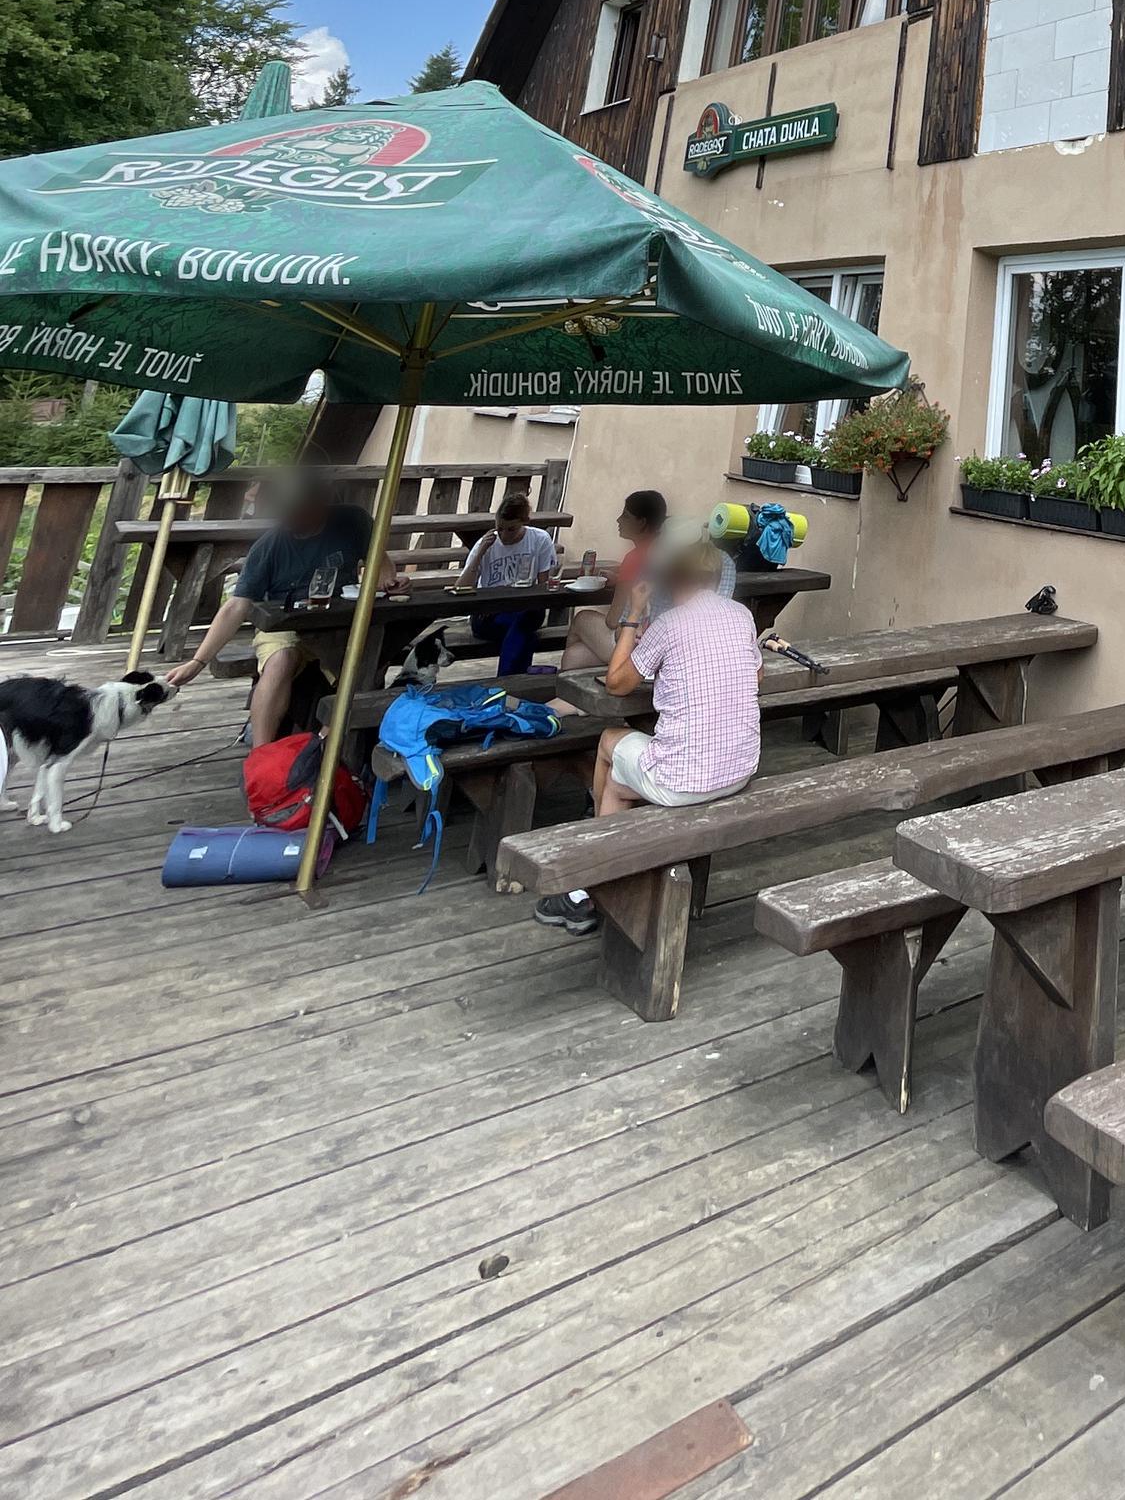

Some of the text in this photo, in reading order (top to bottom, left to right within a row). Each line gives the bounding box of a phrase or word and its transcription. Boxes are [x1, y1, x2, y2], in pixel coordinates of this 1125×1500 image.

[688, 136, 728, 159] RADEGAST
[741, 117, 820, 151] CHATA DUKLA
[81, 159, 462, 201] RADEGAST
